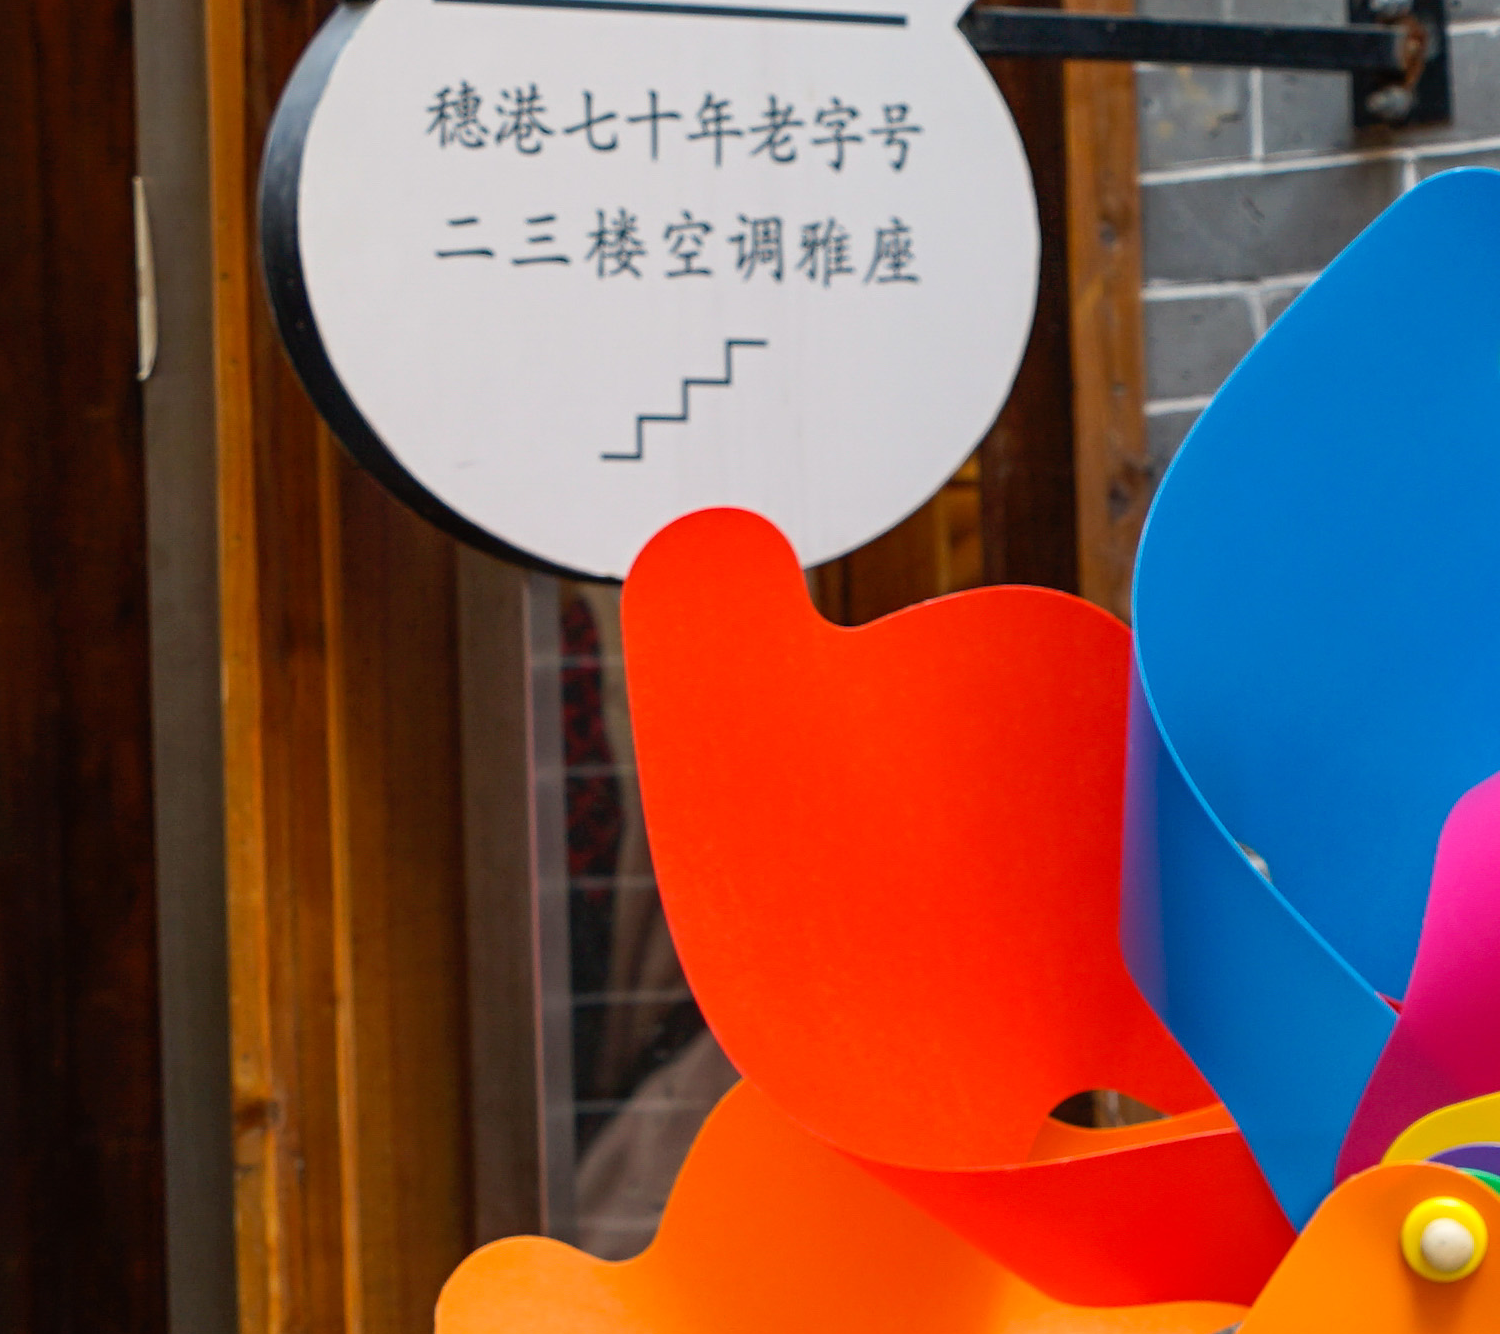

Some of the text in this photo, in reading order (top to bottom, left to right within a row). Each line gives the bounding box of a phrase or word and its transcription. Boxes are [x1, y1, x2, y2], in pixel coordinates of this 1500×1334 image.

[425, 82, 925, 174] 穗港七十年老字号
[434, 208, 923, 289] 二三楼空调雅座
